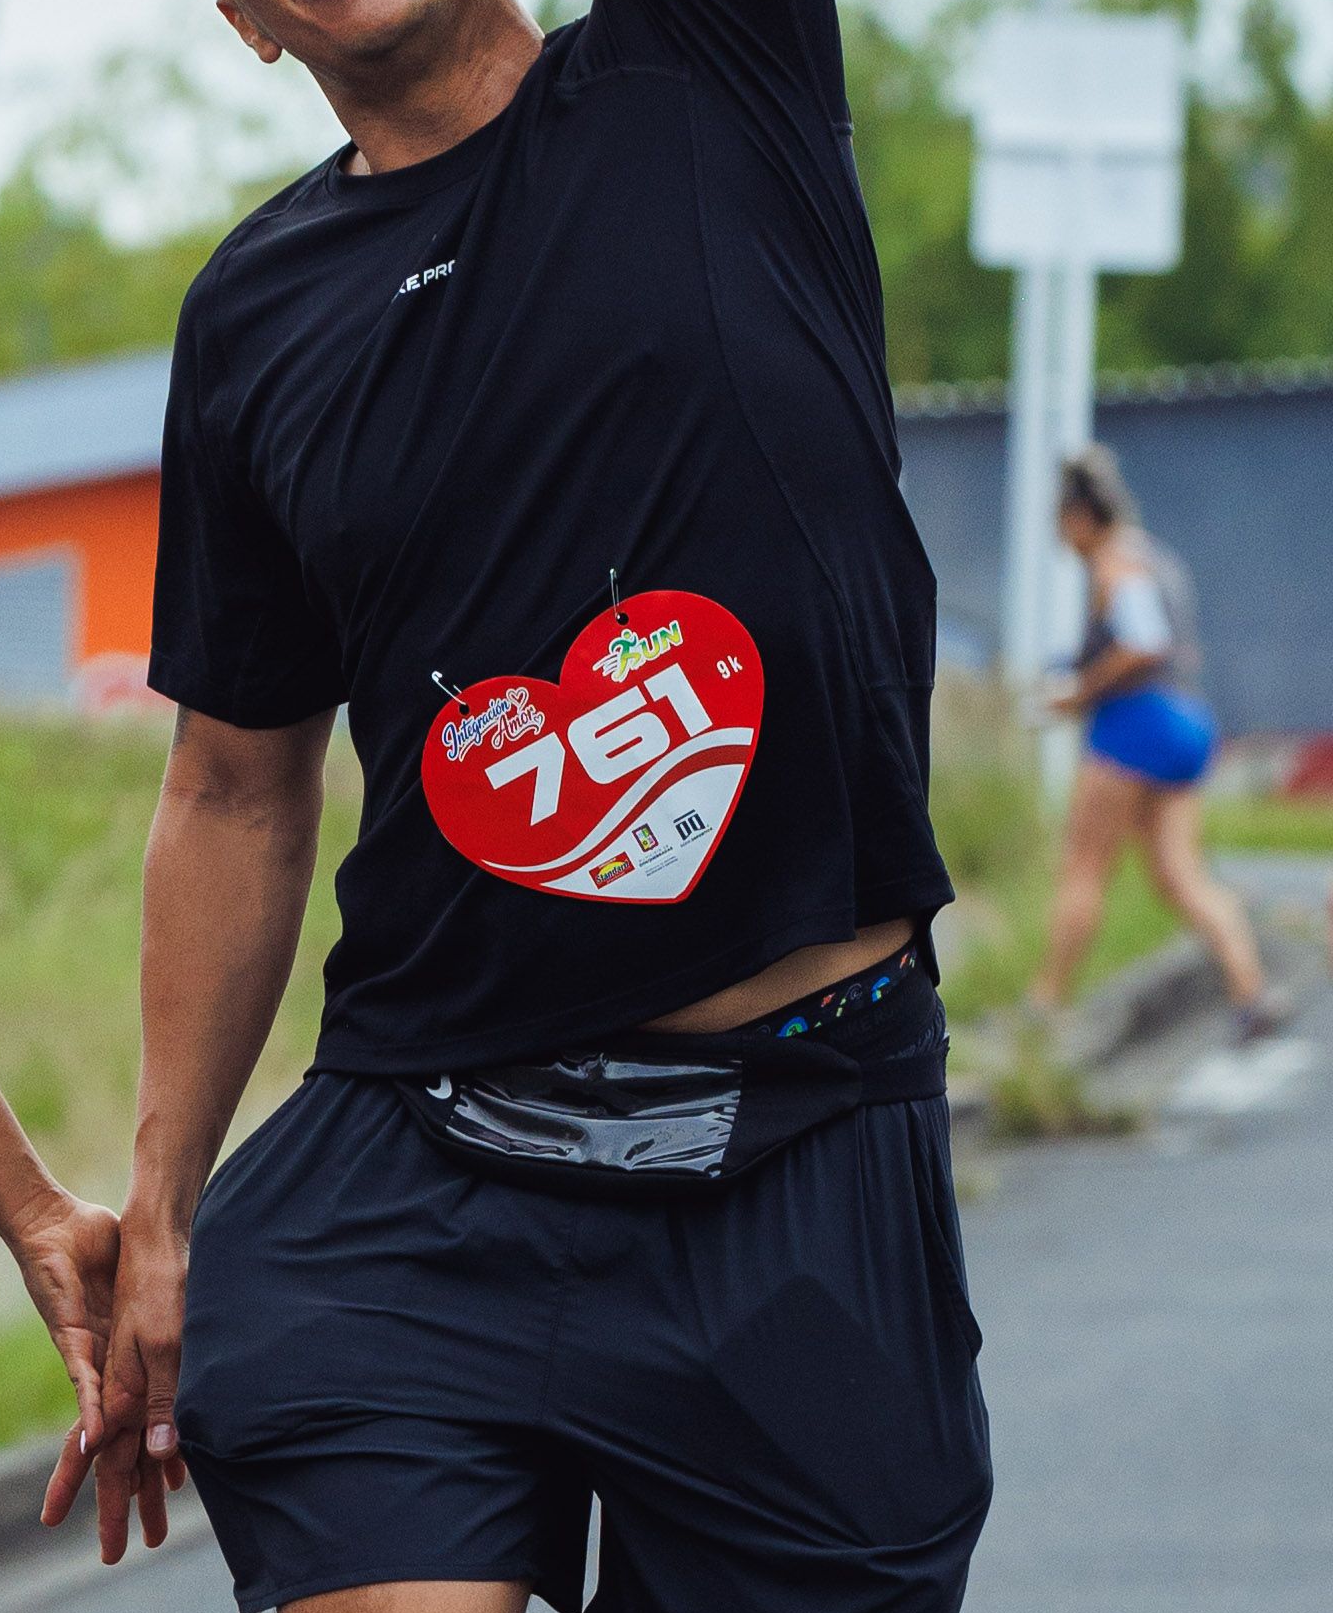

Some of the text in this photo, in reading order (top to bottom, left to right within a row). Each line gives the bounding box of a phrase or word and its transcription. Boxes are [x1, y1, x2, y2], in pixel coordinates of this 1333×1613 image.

[443, 698, 510, 759] Integración
[485, 663, 713, 826] 761
[492, 706, 539, 748] Amor
